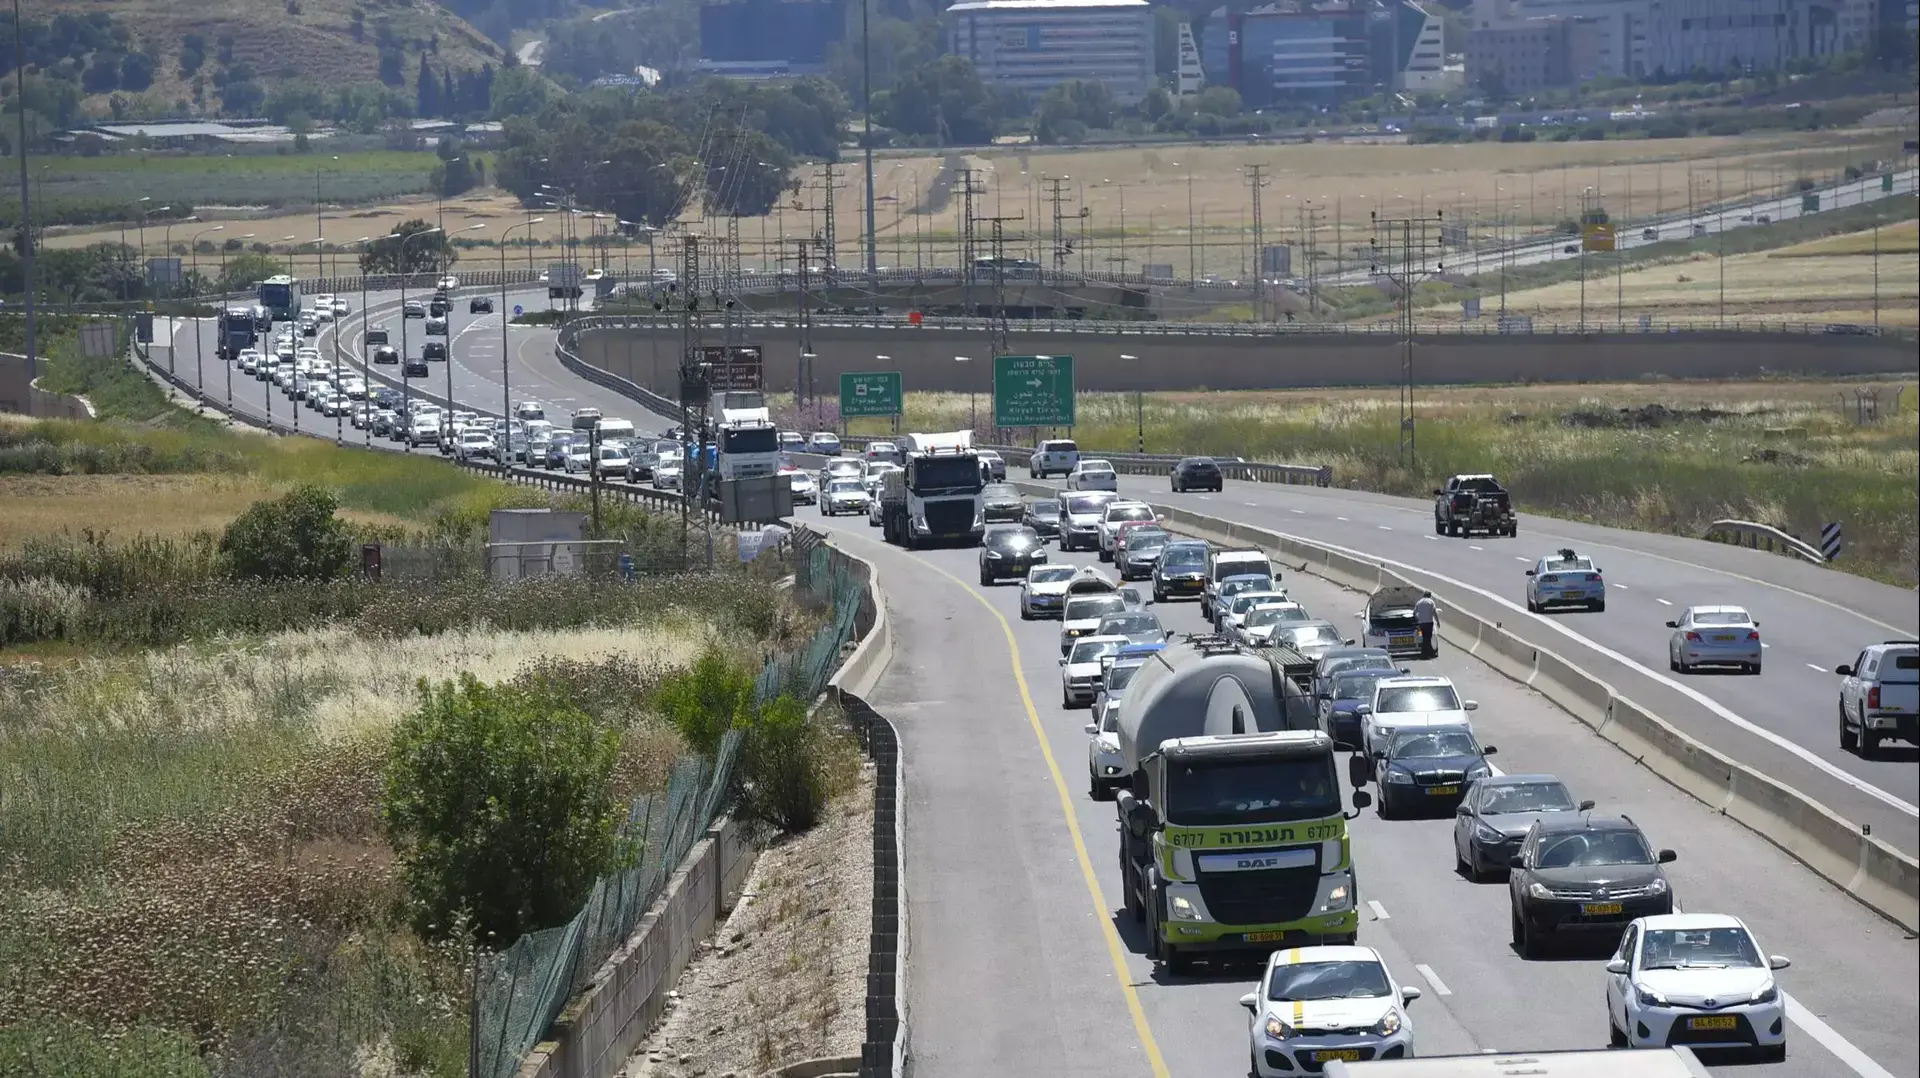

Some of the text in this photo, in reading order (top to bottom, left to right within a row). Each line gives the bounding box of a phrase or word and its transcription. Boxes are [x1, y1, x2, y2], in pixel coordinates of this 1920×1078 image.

[1173, 824, 1338, 846] 6777 תעבורה 6777
[1237, 858, 1278, 868] DAF
